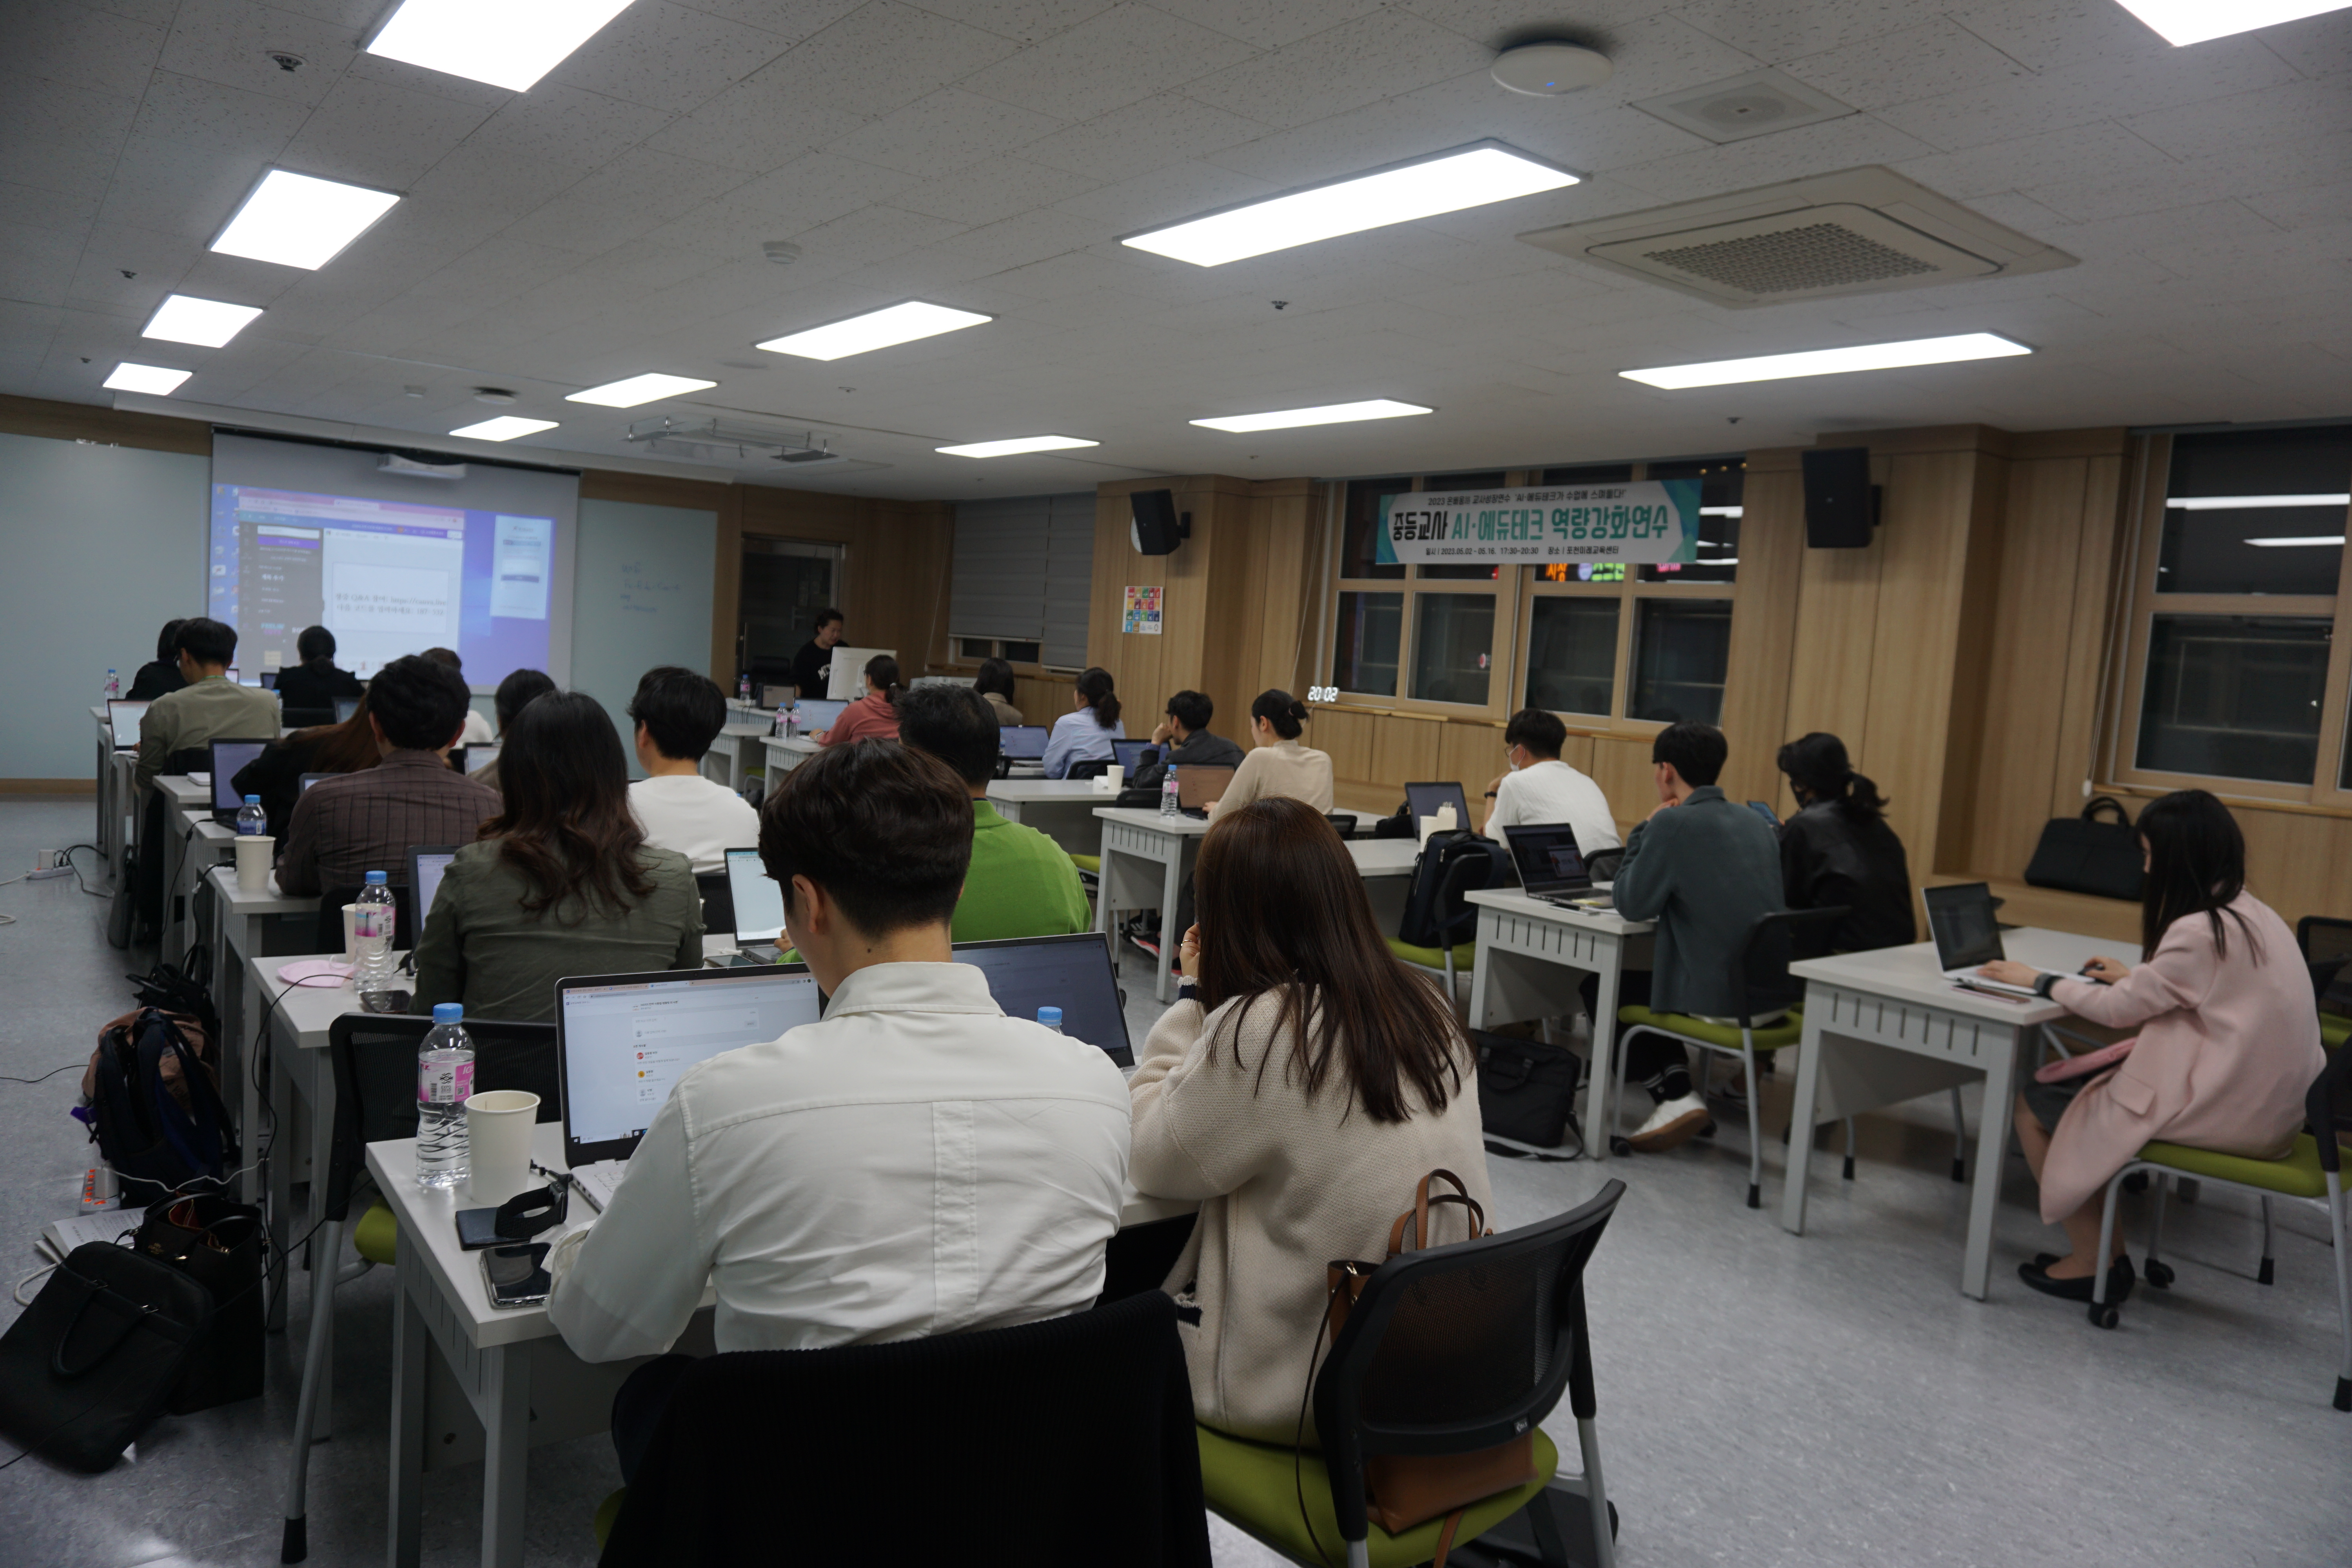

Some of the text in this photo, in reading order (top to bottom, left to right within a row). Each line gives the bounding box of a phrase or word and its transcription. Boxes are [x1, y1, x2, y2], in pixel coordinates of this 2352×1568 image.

[1472, 494, 1510, 504] 교사성장연수
[1566, 490, 1588, 500] 수업에
[1393, 505, 1668, 541] 중등교사 AI·에듀테크 역량강화연수
[1548, 546, 1560, 554] 장소
[1566, 545, 1619, 555] 포천미래교육센터
